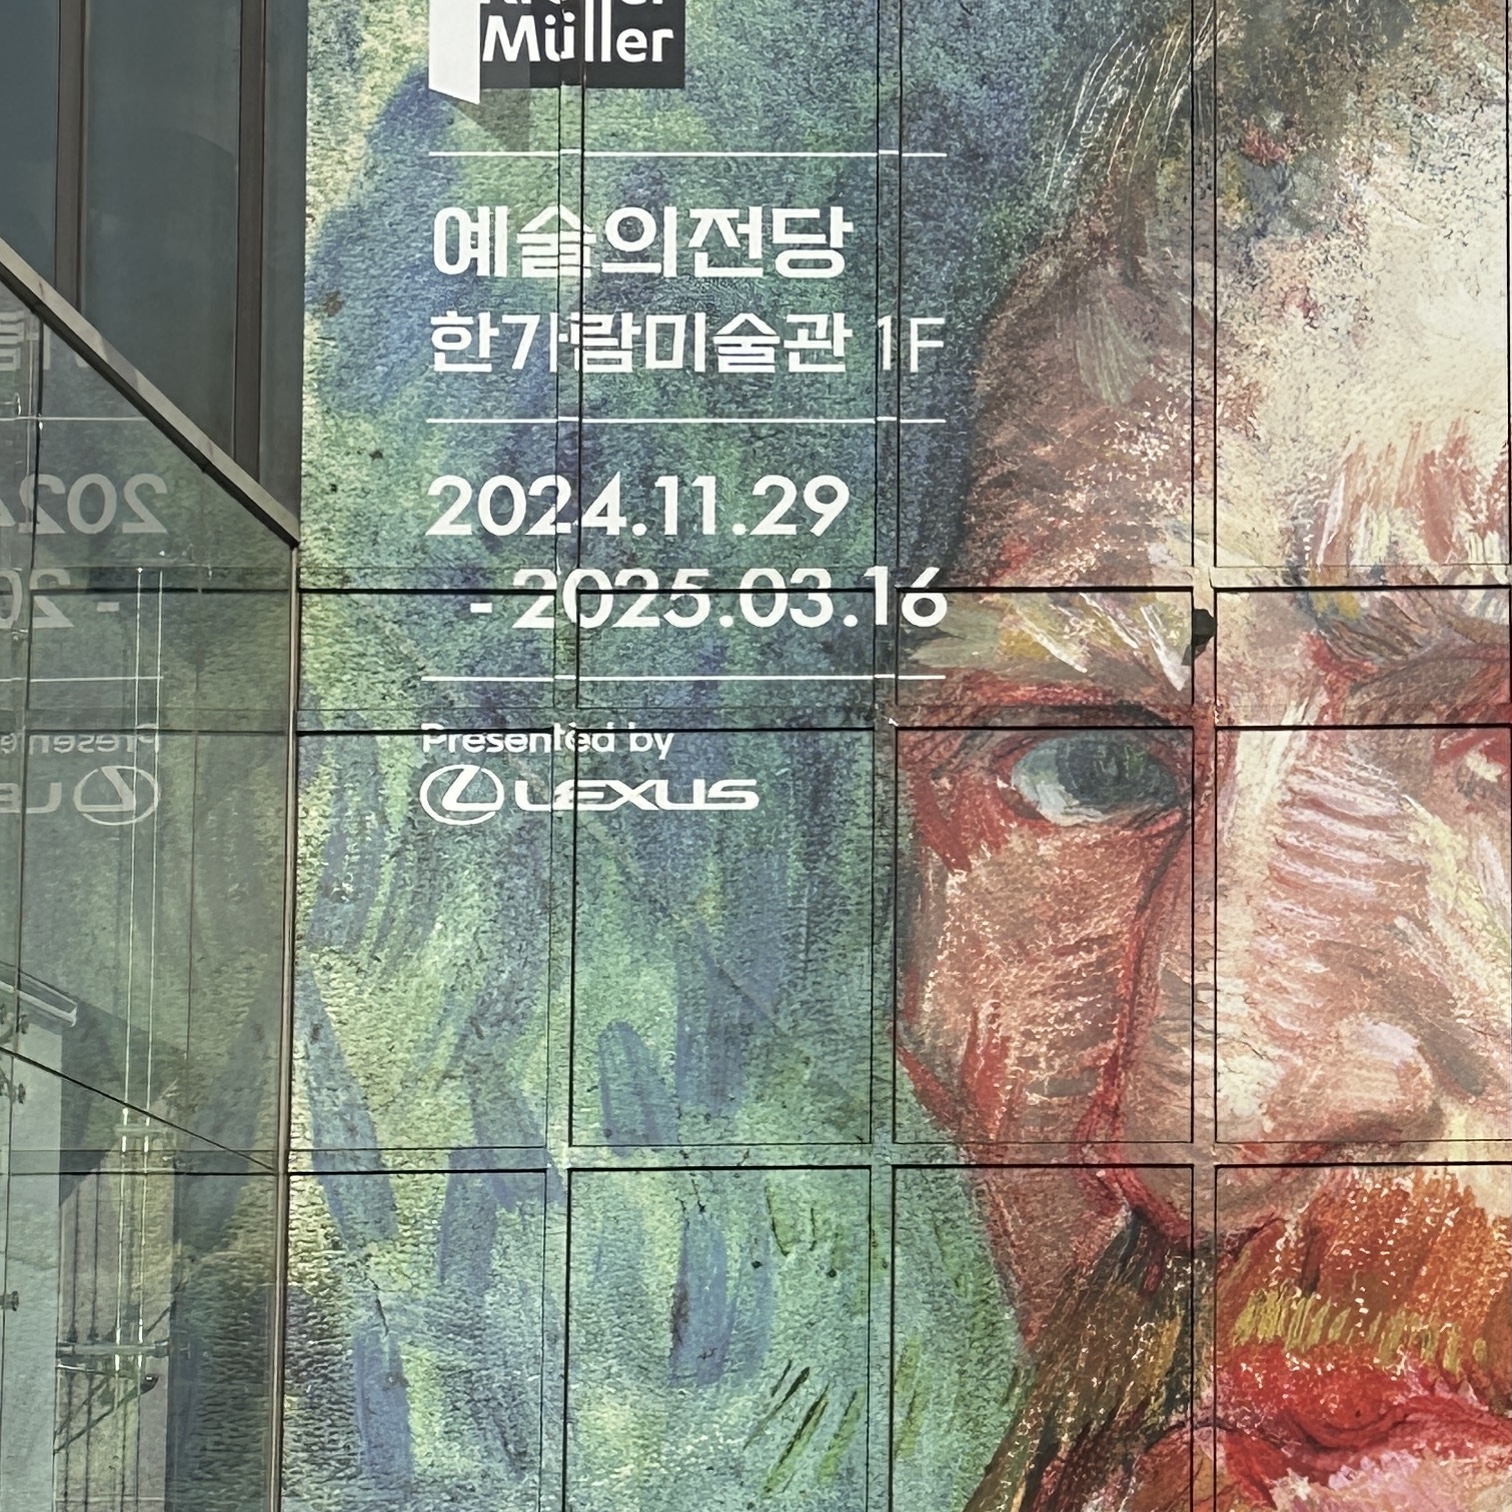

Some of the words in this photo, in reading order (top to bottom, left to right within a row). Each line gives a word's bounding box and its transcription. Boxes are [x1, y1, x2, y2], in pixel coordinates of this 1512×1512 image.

[482, 9, 674, 63] Müller
[432, 205, 854, 279] 예술의전당
[430, 311, 853, 374] 한가람미술관
[876, 317, 946, 373] 1F
[425, 471, 850, 538] 2024.11.29
[511, 565, 948, 629] 2025.03.16
[420, 722, 615, 754] Presented
[629, 722, 675, 760] by
[514, 778, 760, 812] LEXUS
